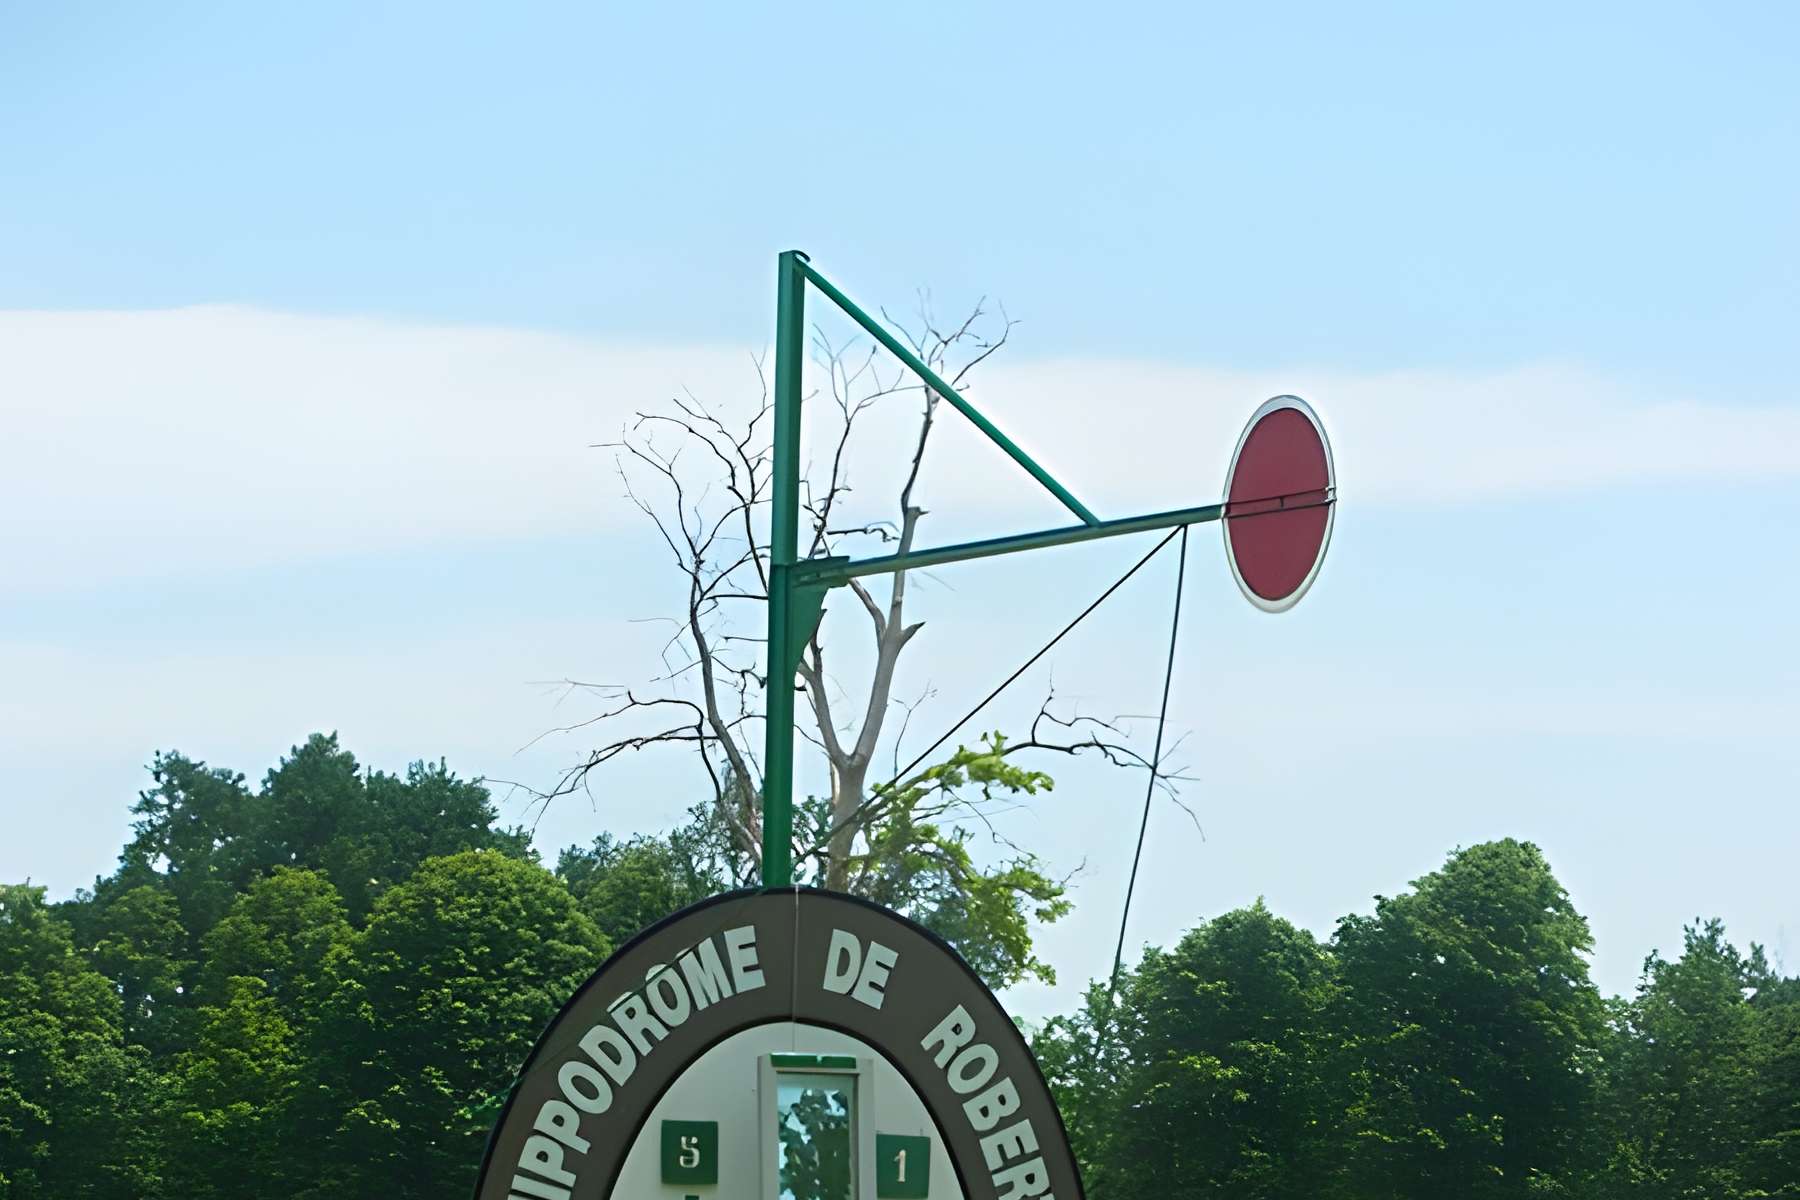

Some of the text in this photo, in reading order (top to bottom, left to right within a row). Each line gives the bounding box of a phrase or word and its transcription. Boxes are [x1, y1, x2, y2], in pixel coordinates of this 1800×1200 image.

[823, 929, 898, 1009] DE
[679, 1135, 701, 1169] 5
[893, 1149, 907, 1183] 1
